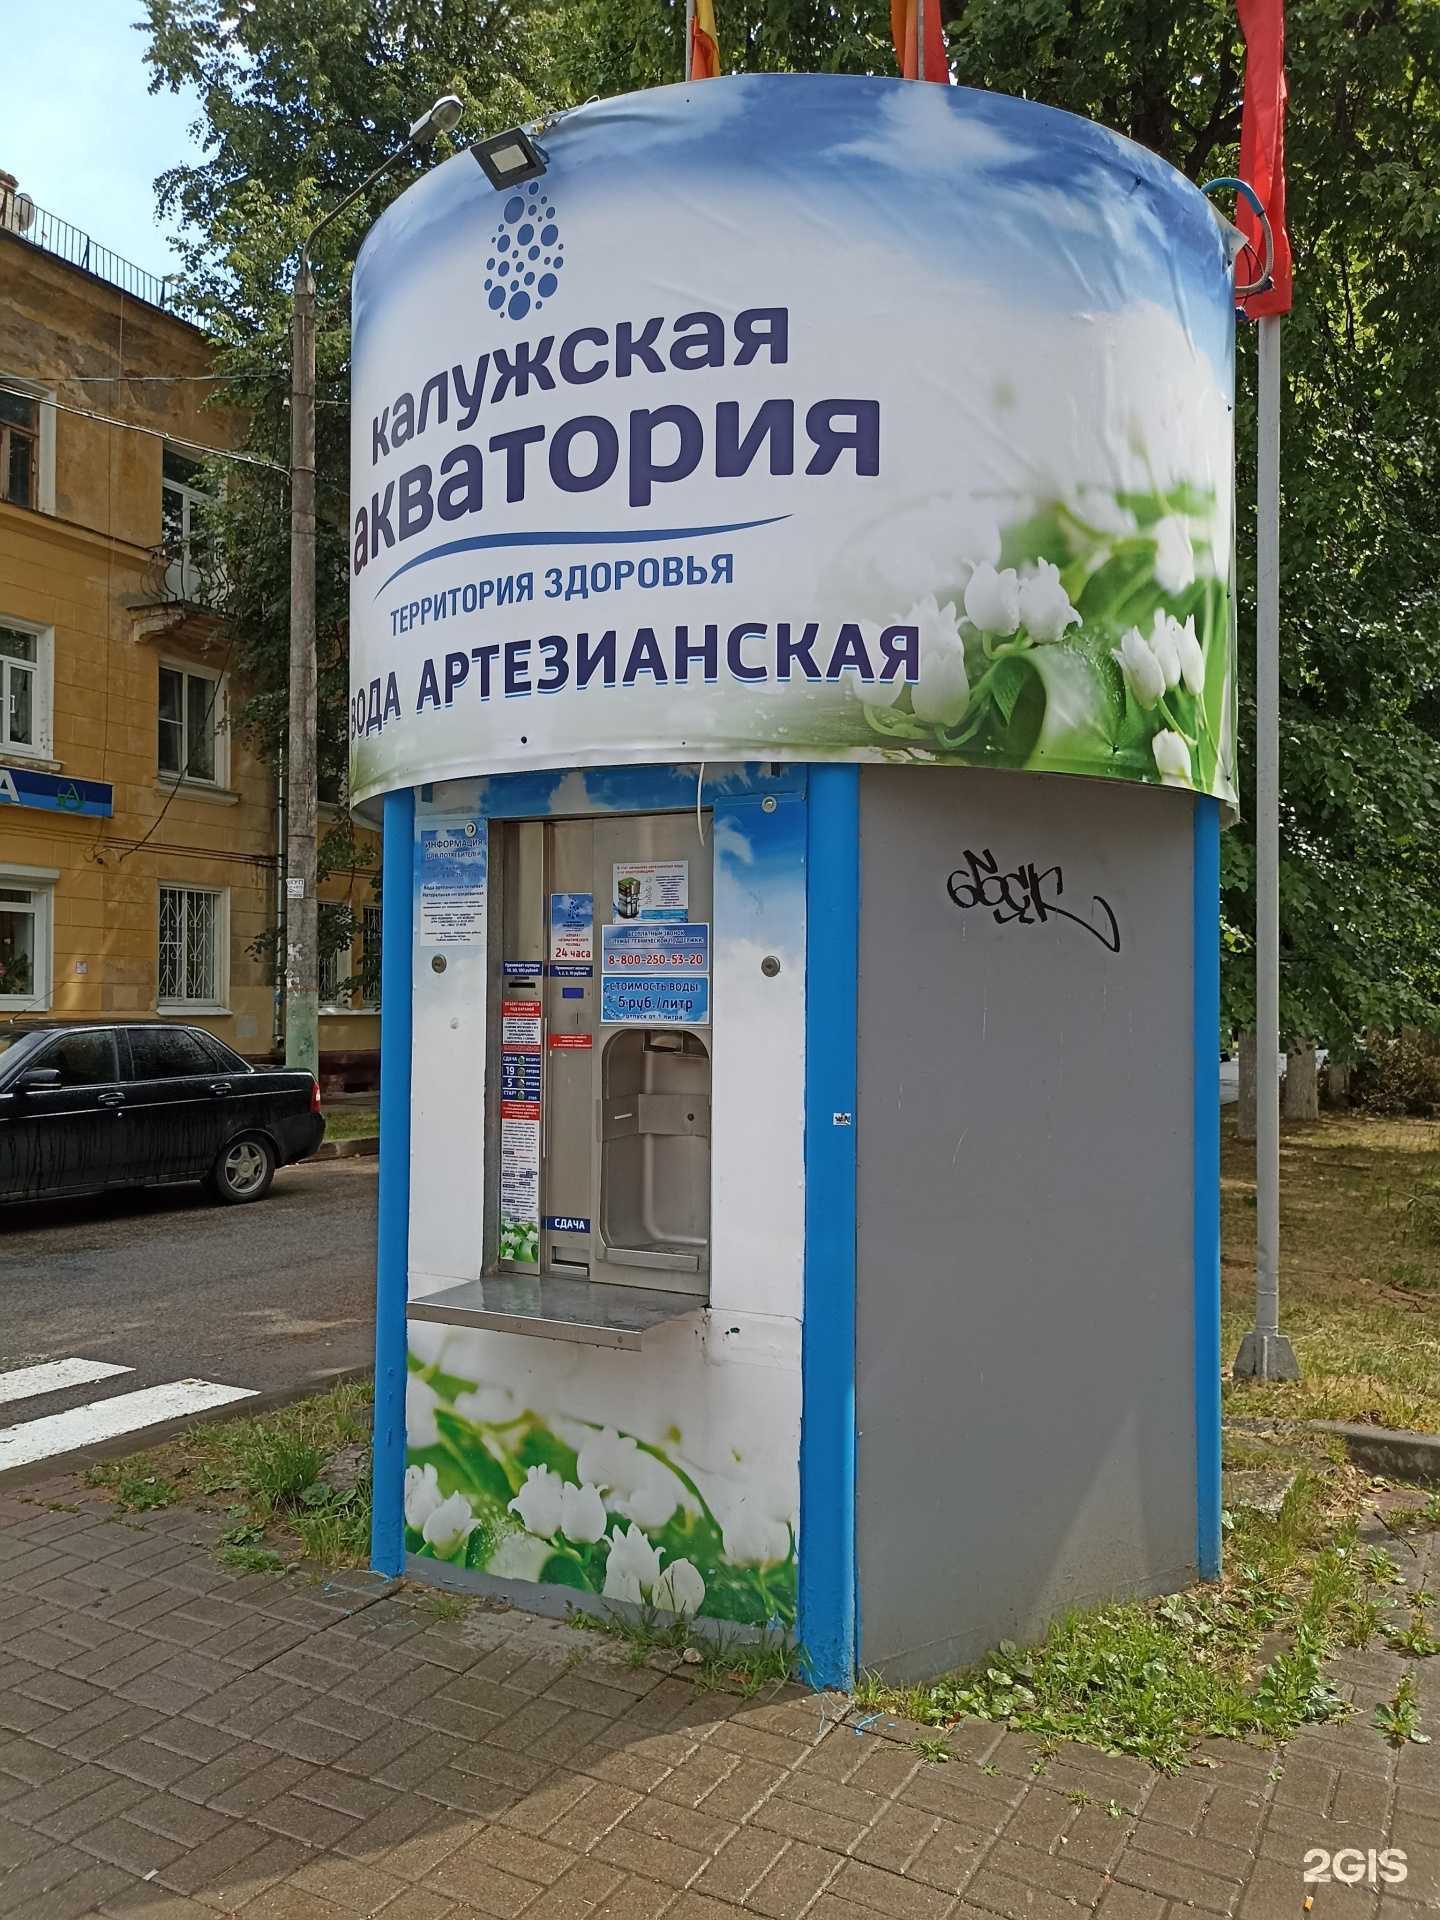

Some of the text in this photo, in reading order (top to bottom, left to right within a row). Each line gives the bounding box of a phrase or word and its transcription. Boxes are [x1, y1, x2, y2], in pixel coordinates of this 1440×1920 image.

[372, 307, 789, 465] калужская
[353, 398, 880, 576] акватория
[390, 553, 734, 637] ТЕРРИТОРИЯ ЗДОРОВЬЯ
[415, 622, 920, 712] АРТЕЗИАНСКАЯ
[424, 839, 483, 849] ИНФОРМАЦИЯ
[555, 948, 591, 958] 24 часа
[608, 954, 704, 966] 8-800-250-53-20
[609, 982, 699, 993] СТОИМОСТЬ ВОДЫ
[505, 1066, 515, 1075] 19
[507, 1078, 513, 1087] 5
[554, 1218, 586, 1230] СДАЧА
